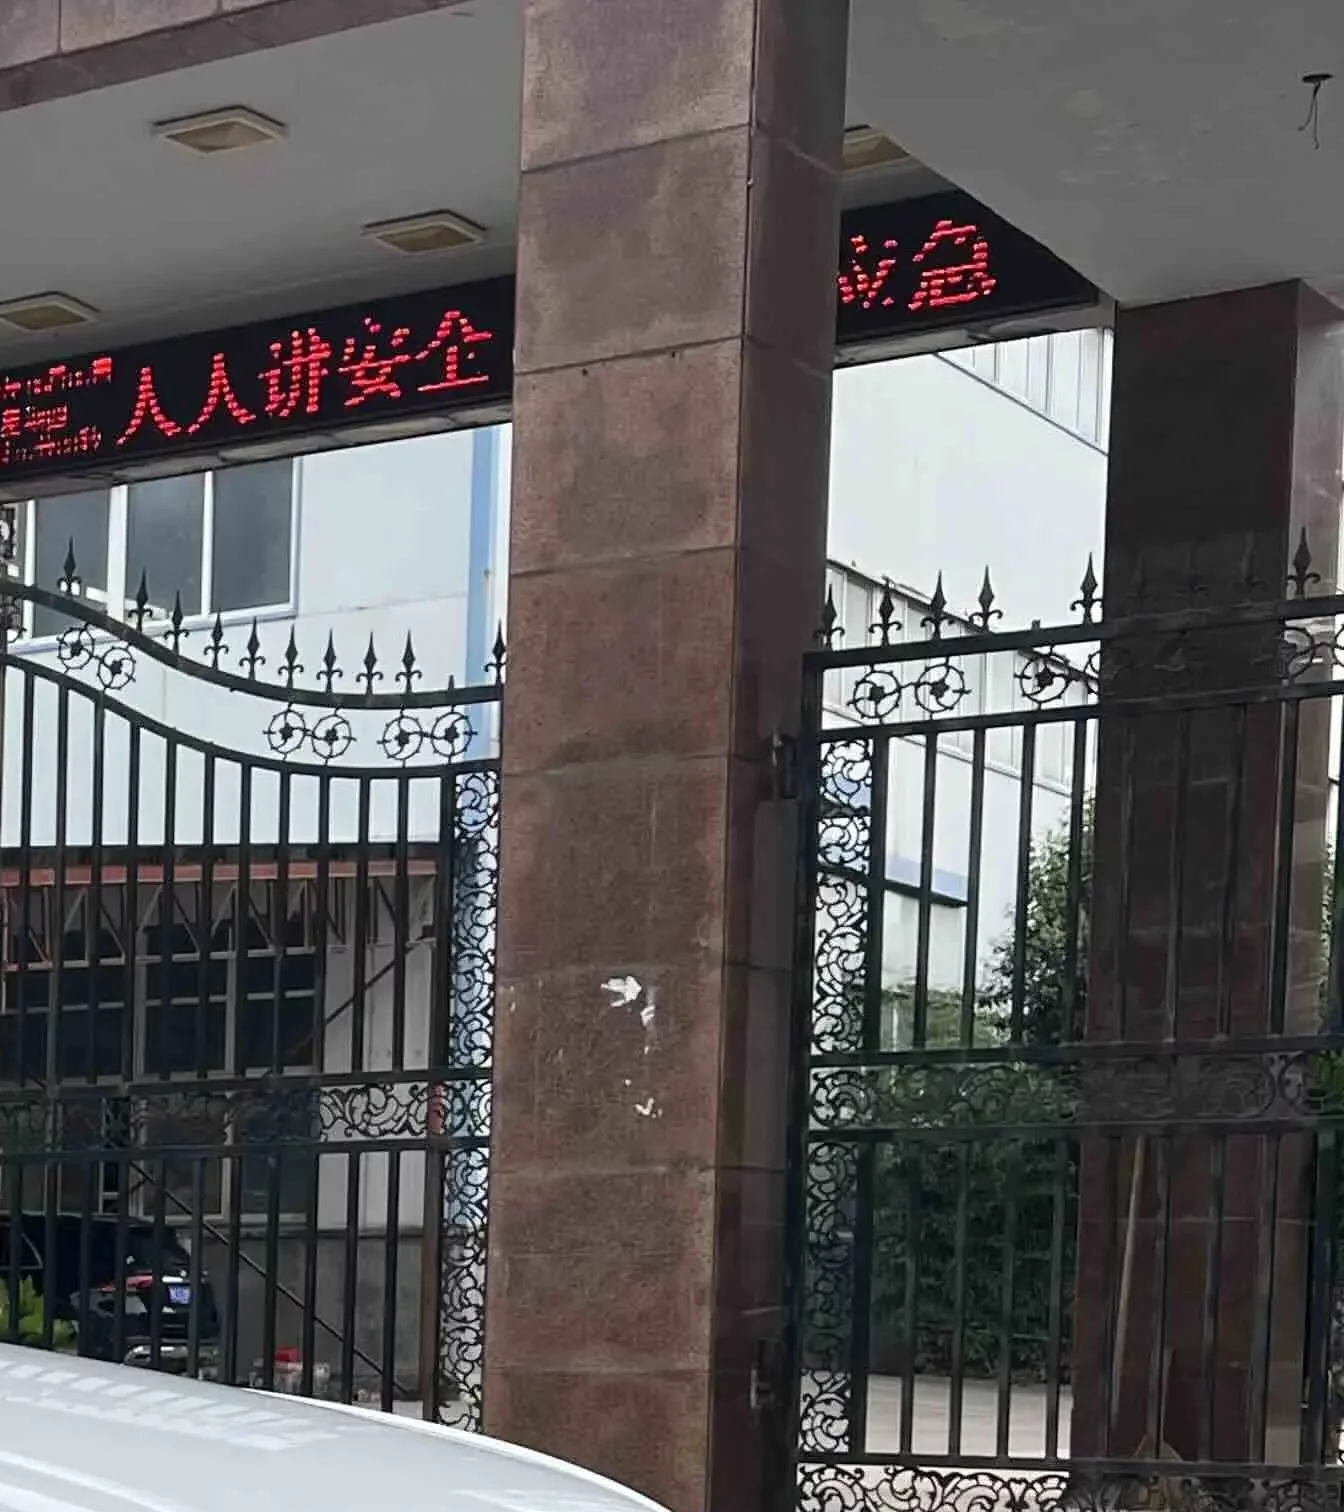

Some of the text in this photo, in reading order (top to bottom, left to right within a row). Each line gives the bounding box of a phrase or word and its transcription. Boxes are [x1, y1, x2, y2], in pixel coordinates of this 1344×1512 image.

[115, 309, 494, 447] 人人讲安全
